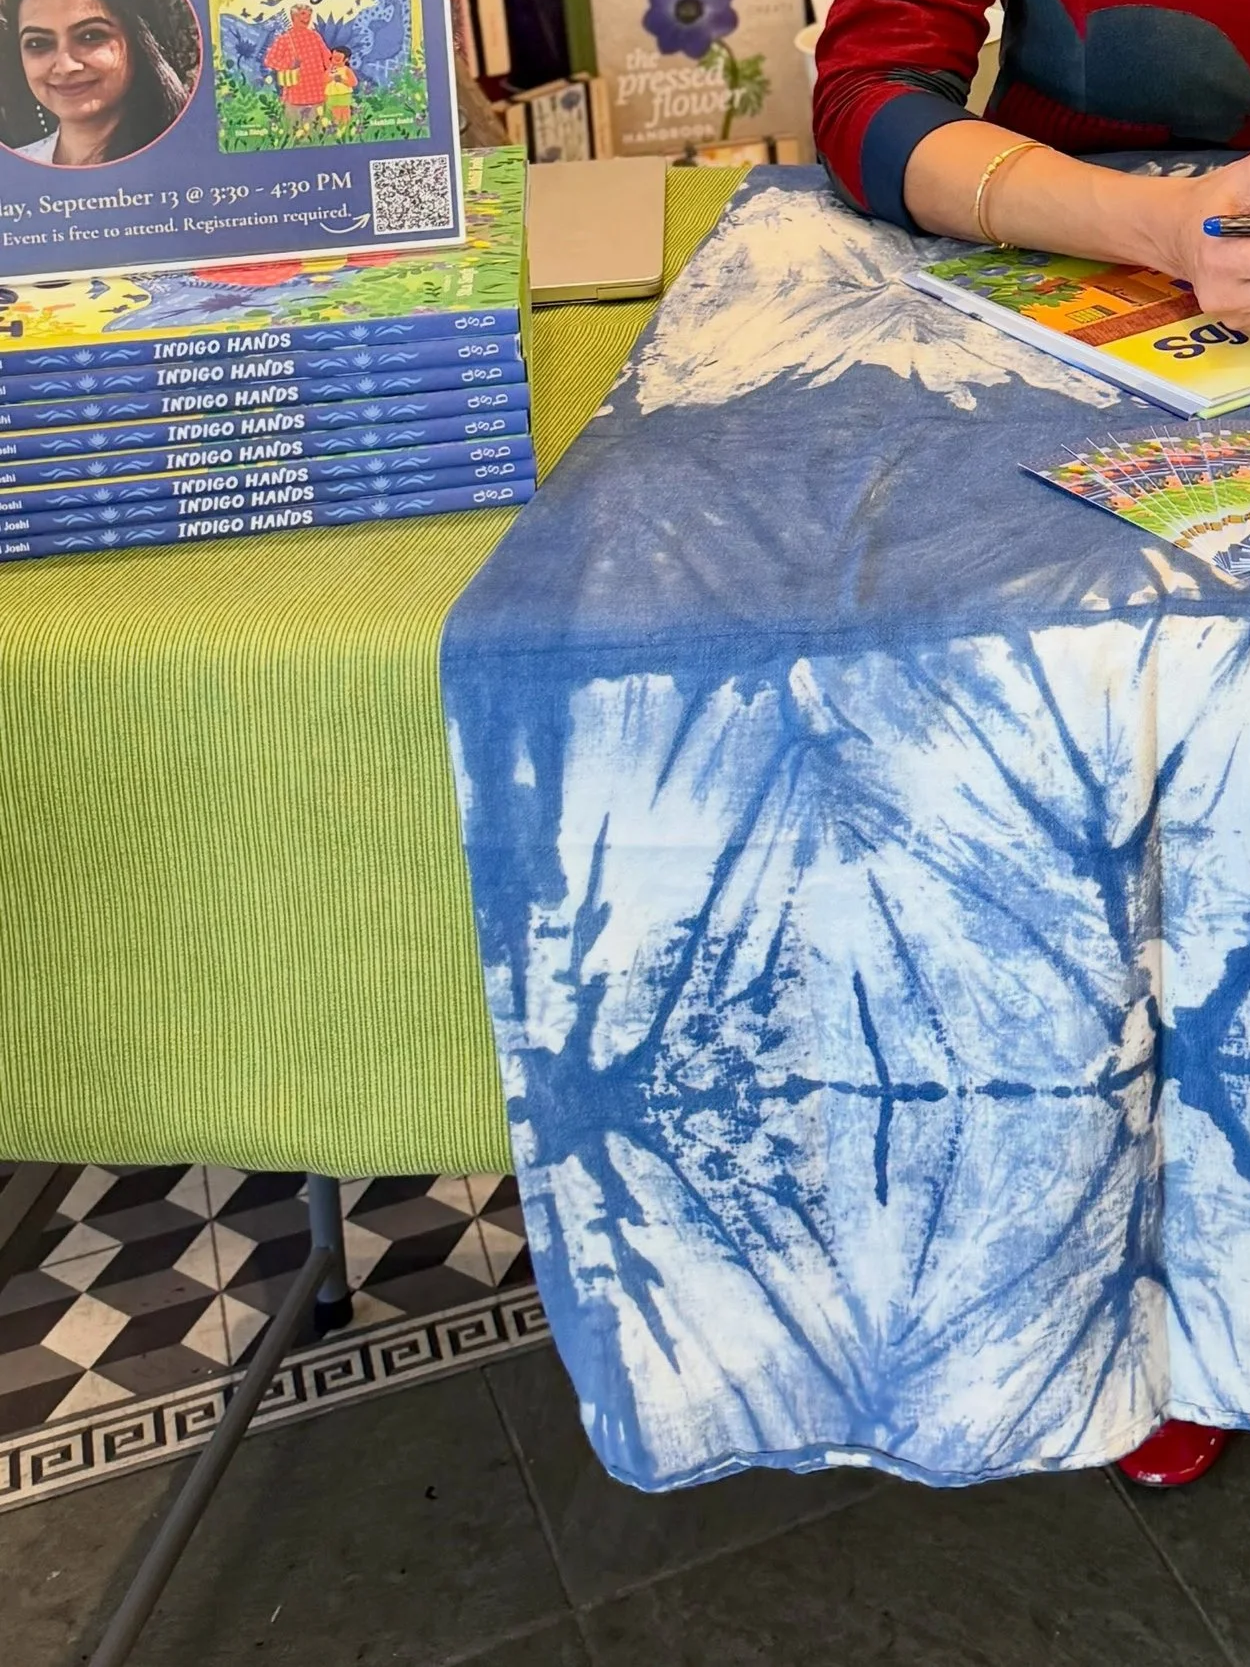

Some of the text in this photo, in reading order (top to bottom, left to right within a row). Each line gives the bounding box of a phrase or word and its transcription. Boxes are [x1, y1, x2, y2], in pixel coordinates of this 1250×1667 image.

[626, 47, 661, 70] the
[616, 57, 725, 106] pressed
[645, 86, 746, 128] flower
[39, 188, 153, 218] September
[160, 192, 179, 209] 13
[186, 186, 204, 203] @
[210, 184, 250, 202] 3:30
[271, 179, 311, 198] 4:30
[316, 171, 352, 191] PM
[3, 203, 352, 247] Event is free to attend. Registration required.
[153, 333, 292, 360] INDIGO HANDS
[157, 359, 295, 386] INDIGO HANDS
[161, 386, 299, 413] INDIGO HANDS
[167, 413, 305, 442] INDIGO HANDS
[166, 441, 303, 470] INDIGO HANDS
[172, 468, 309, 496] INDIGO HANDS
[178, 486, 315, 515] INDIGO HANDS
[4, 519, 29, 531] Joshi
[177, 510, 314, 539] INDIGO HANDS
[4, 543, 30, 554] Joshi
